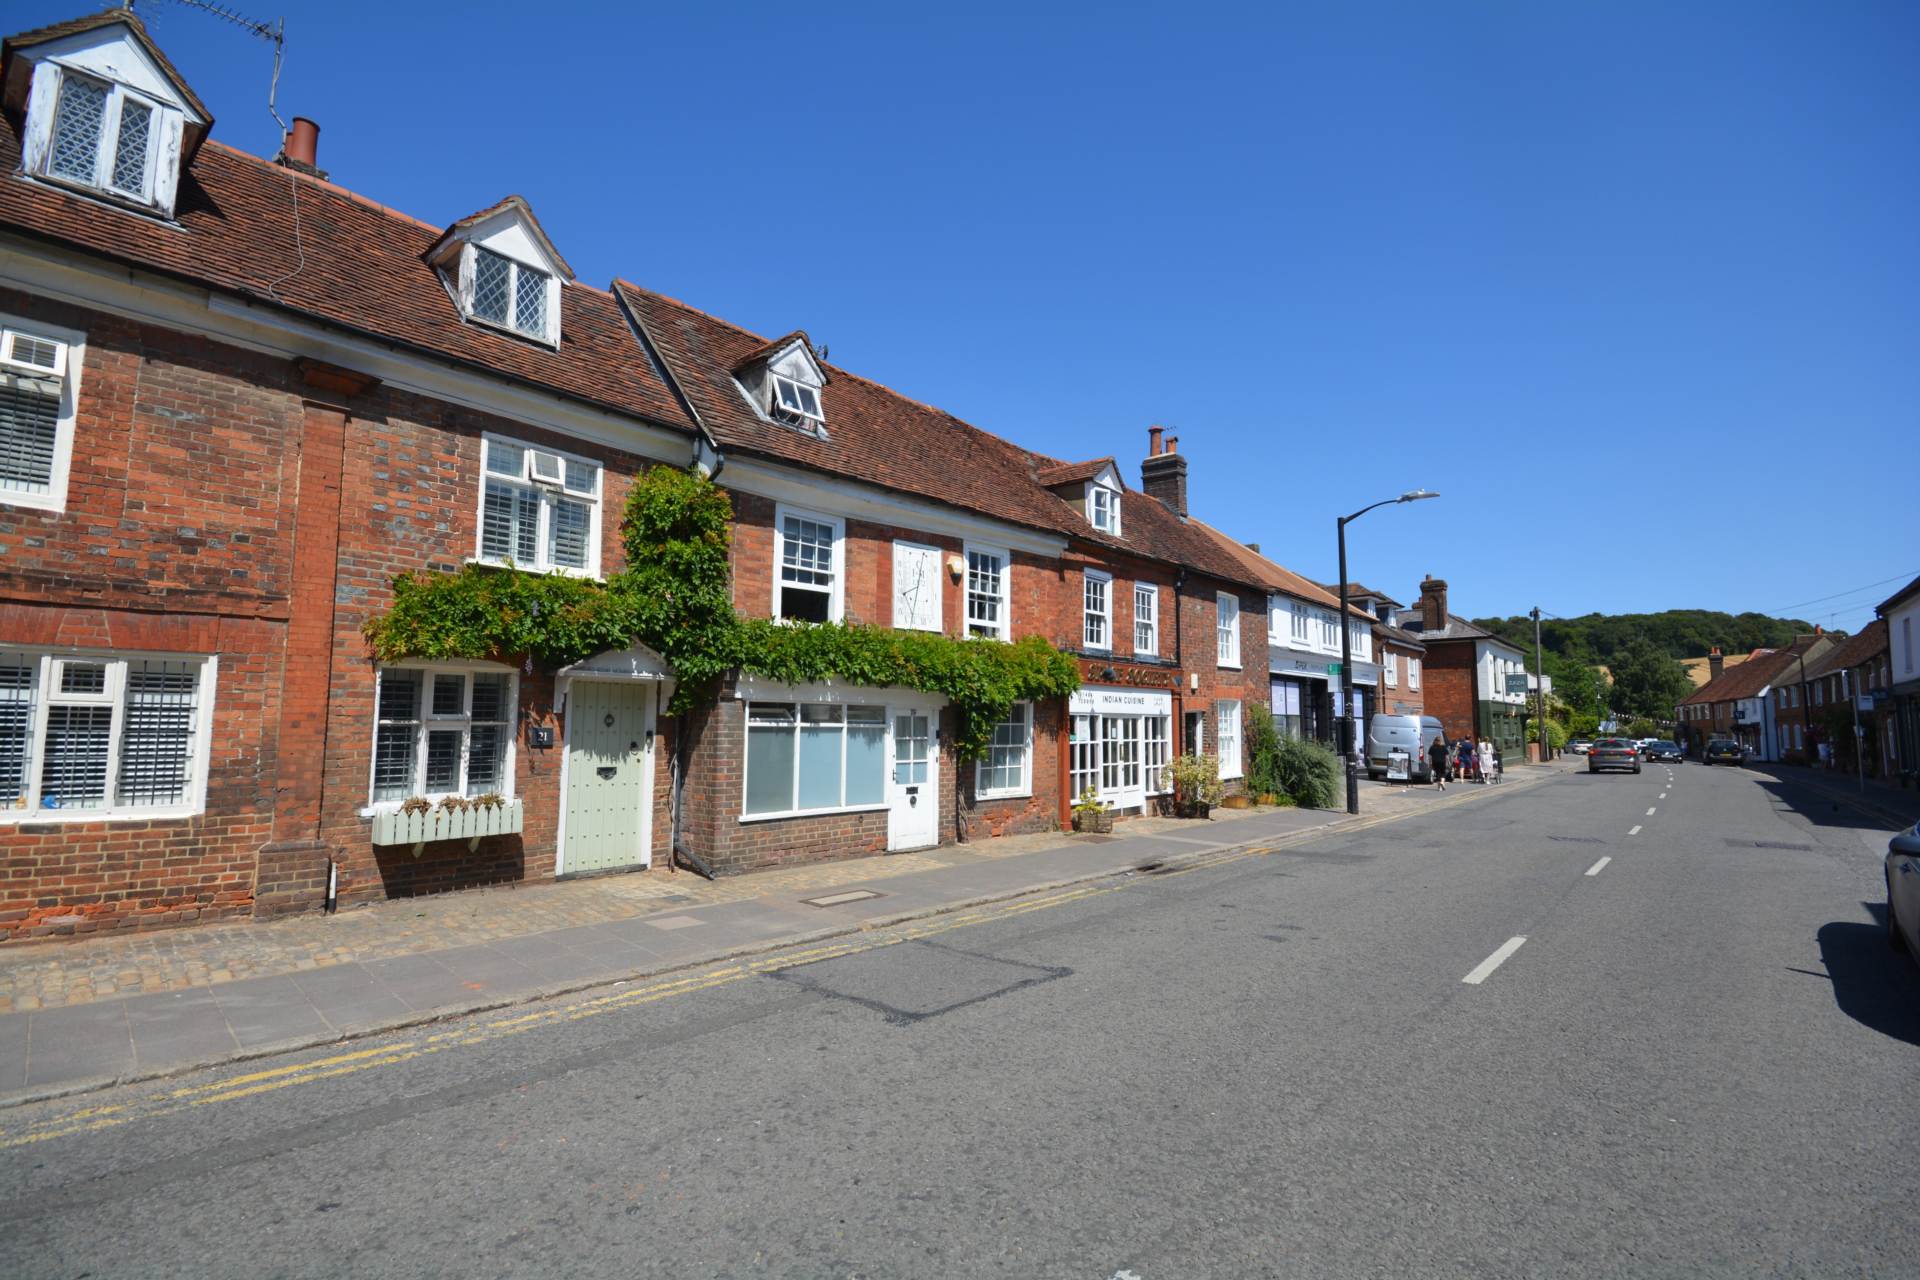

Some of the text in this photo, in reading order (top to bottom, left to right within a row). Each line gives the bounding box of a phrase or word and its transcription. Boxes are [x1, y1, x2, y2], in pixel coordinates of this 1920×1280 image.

[1088, 663, 1123, 682] SPE
[1103, 695, 1122, 704] INDIAN
[1124, 696, 1144, 705] CUISINE
[538, 731, 547, 742] 21
